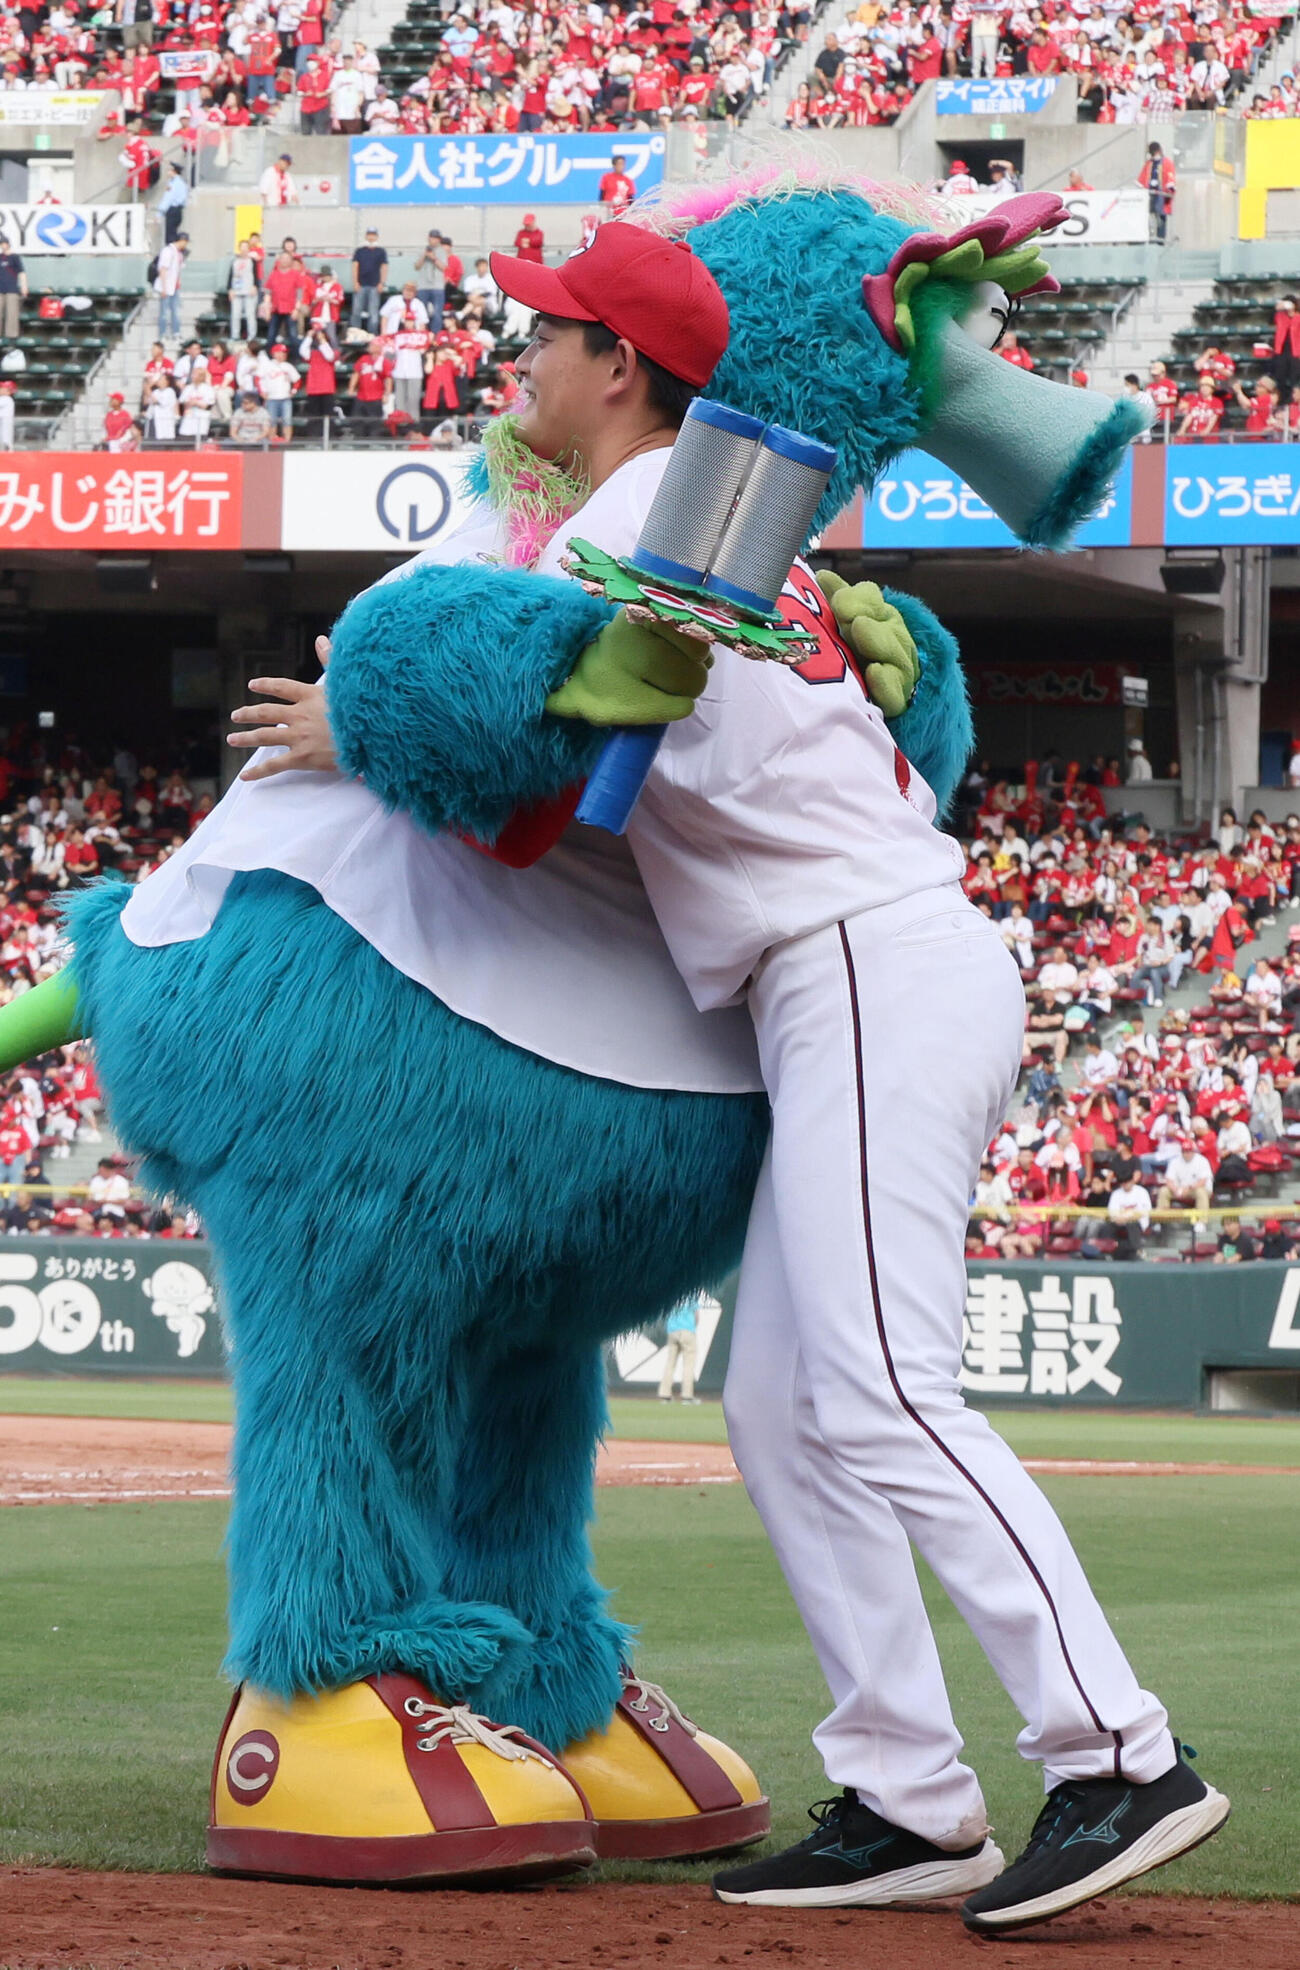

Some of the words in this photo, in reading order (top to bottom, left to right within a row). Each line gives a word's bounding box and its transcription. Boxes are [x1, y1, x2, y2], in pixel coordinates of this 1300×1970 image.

[352, 136, 665, 190] 合人社グループ
[1172, 474, 1300, 518] ひろぎ
[44, 1256, 136, 1281] ありがとう
[958, 1274, 1123, 1397] 建設
[228, 1742, 275, 1791] C
